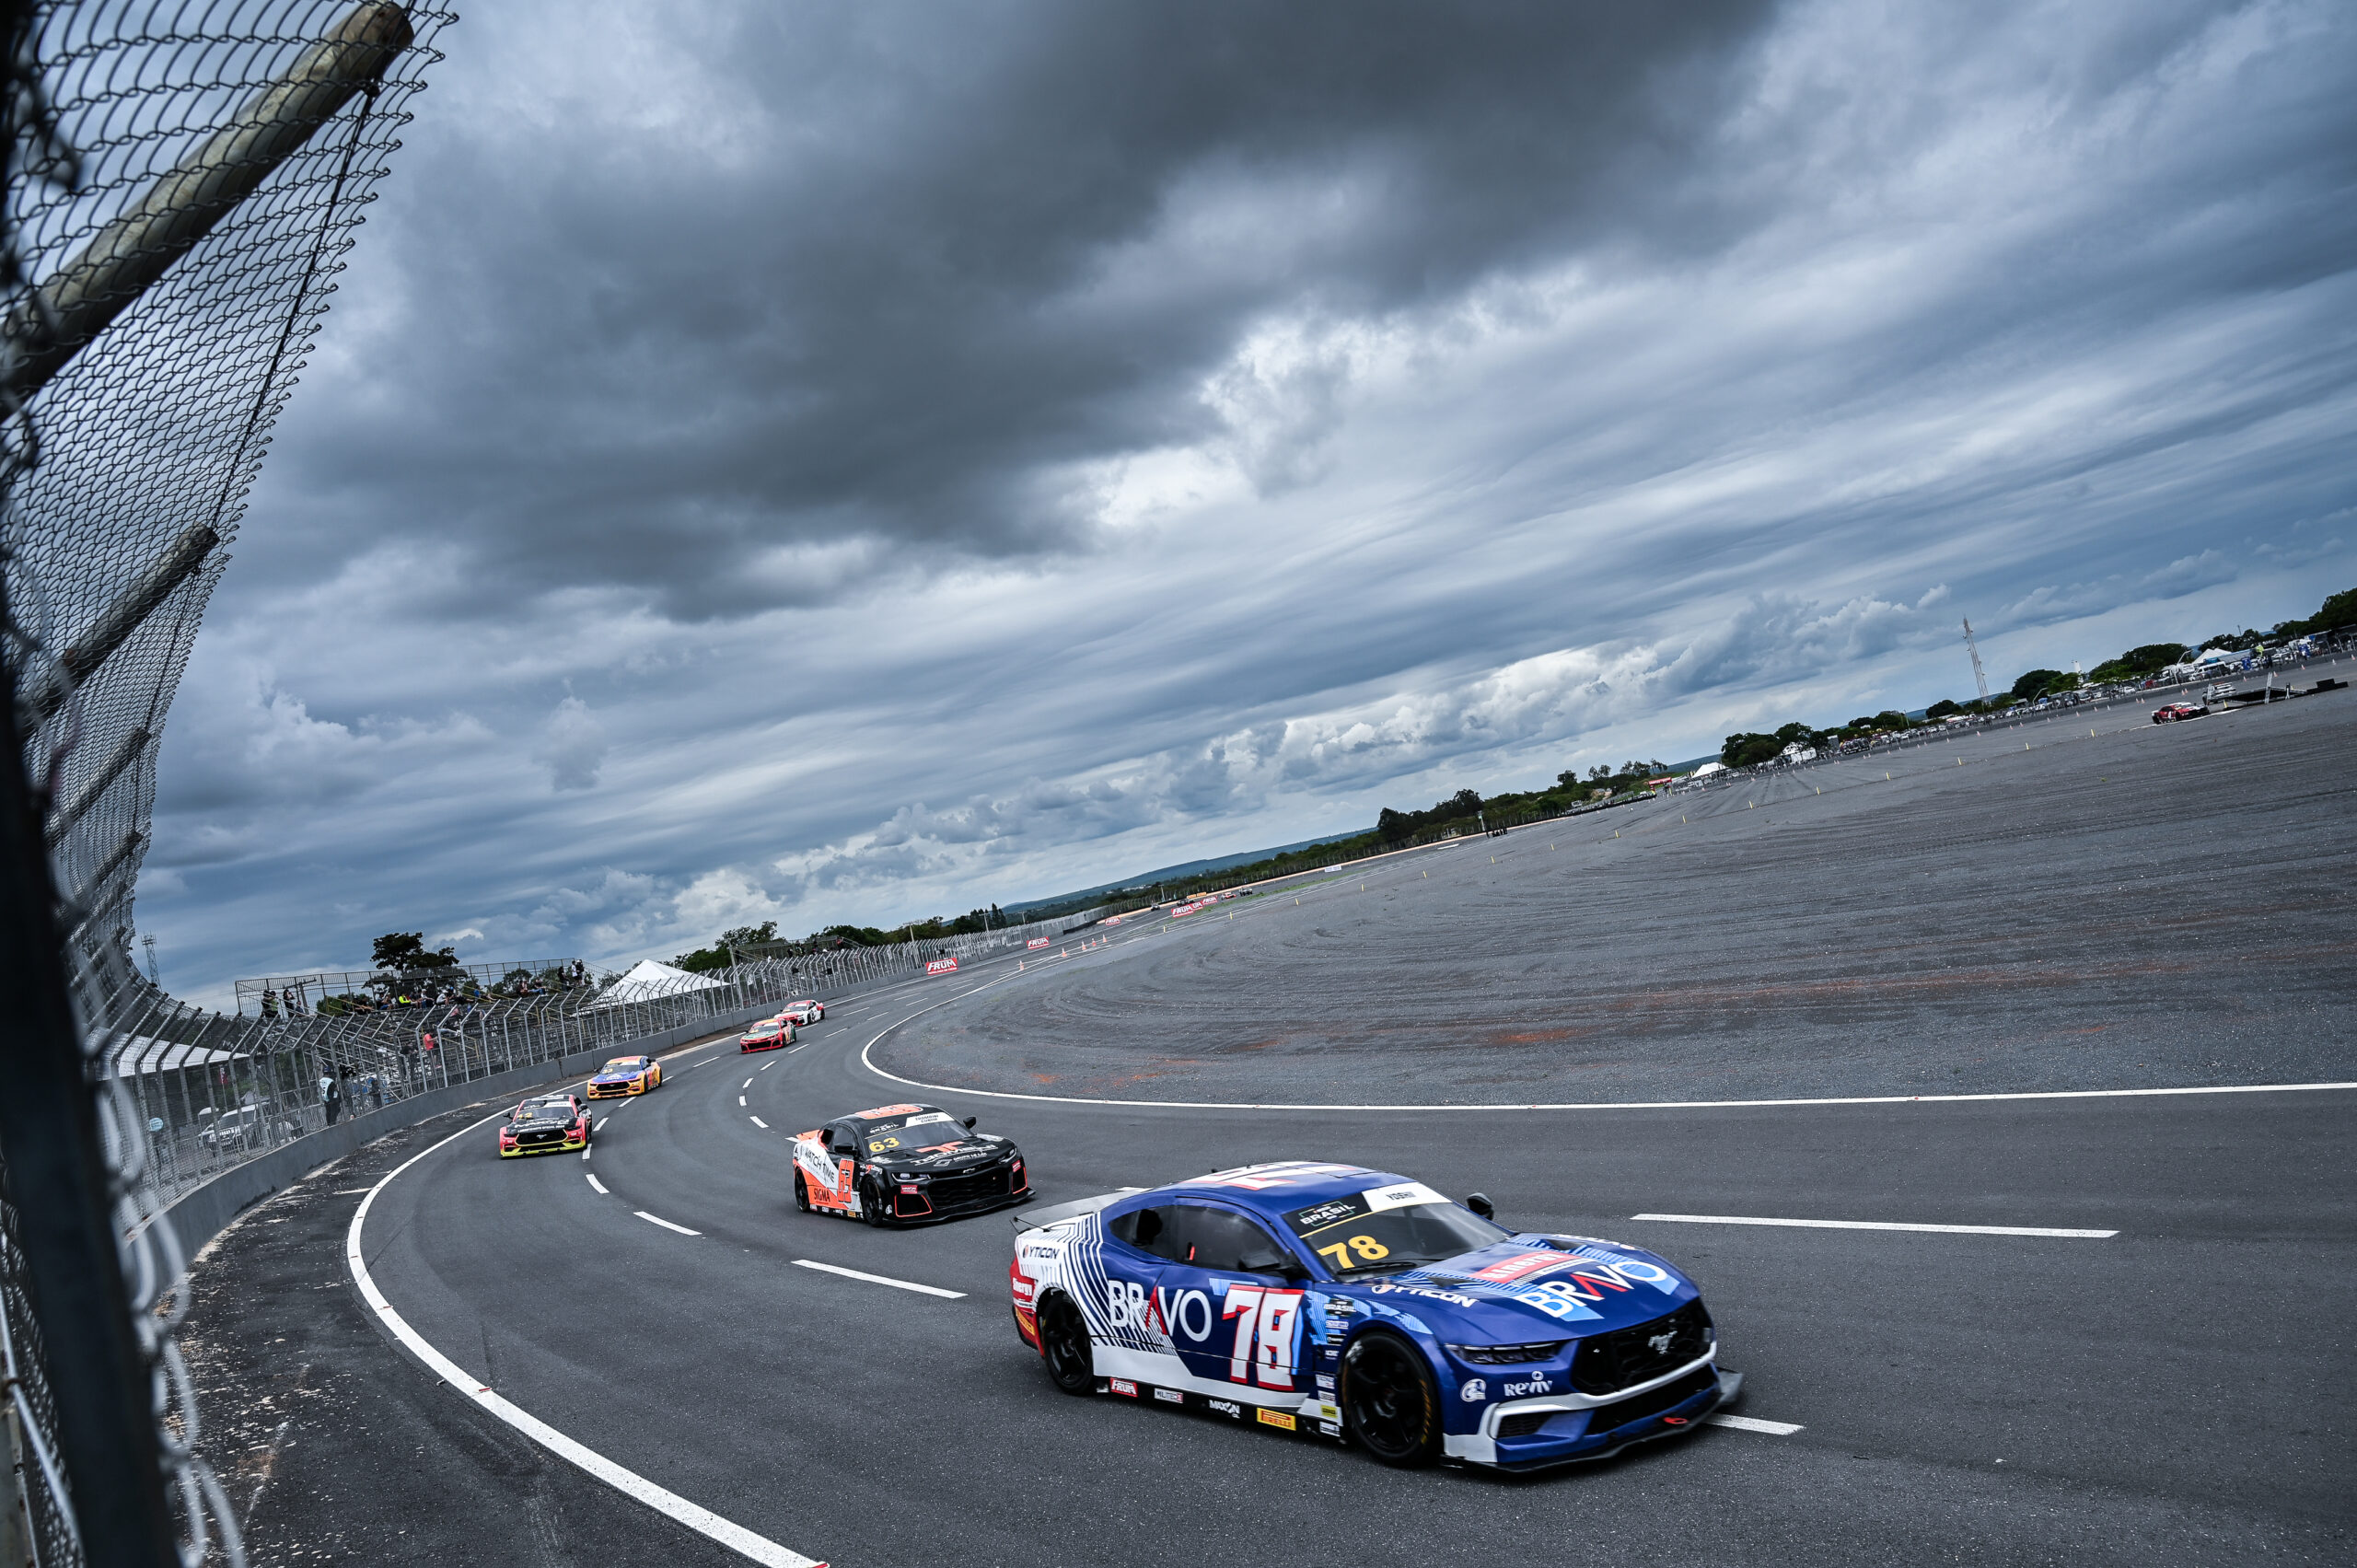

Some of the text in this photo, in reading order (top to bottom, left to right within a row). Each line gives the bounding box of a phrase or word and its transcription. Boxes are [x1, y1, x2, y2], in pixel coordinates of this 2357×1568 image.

[1028, 937, 1049, 947] FRUM
[927, 958, 957, 971] FRUM
[868, 1137, 900, 1153] 63
[813, 1188, 830, 1202] SIGMA
[1300, 1204, 1356, 1225] BRASIL
[1317, 1235, 1389, 1270] 78
[1513, 1260, 1668, 1318] BRAVO
[1108, 1280, 1213, 1342] BRAVO
[1111, 1380, 1136, 1395] FRUM
